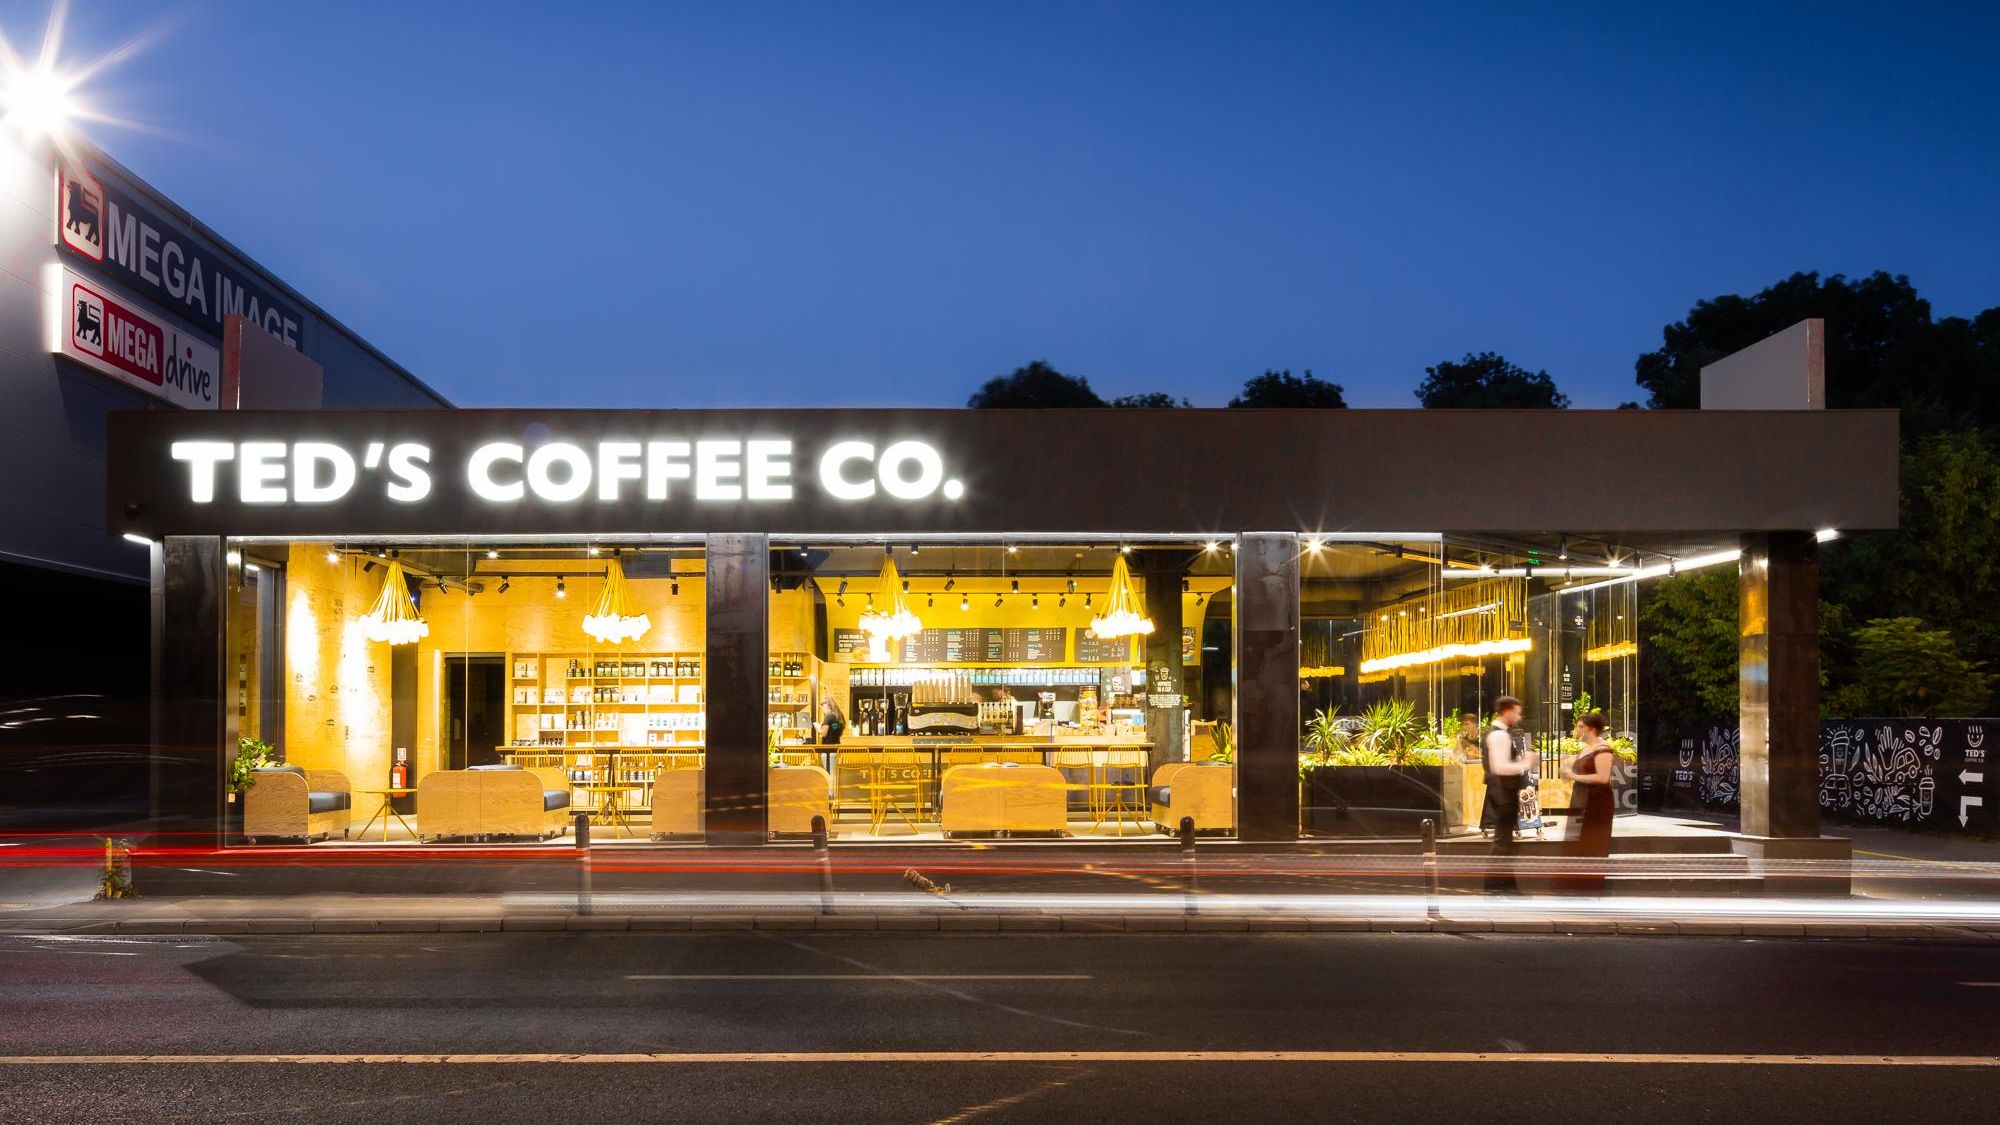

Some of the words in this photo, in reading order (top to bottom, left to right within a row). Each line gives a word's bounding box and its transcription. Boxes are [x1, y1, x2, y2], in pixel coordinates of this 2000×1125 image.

[109, 201, 208, 316] MEGA
[108, 312, 158, 375] MEGA
[165, 334, 211, 401] drive
[171, 441, 432, 503] TED'S
[467, 440, 793, 502] COFFEE
[818, 440, 964, 502] CO.
[1965, 749, 1985, 757] TED'S
